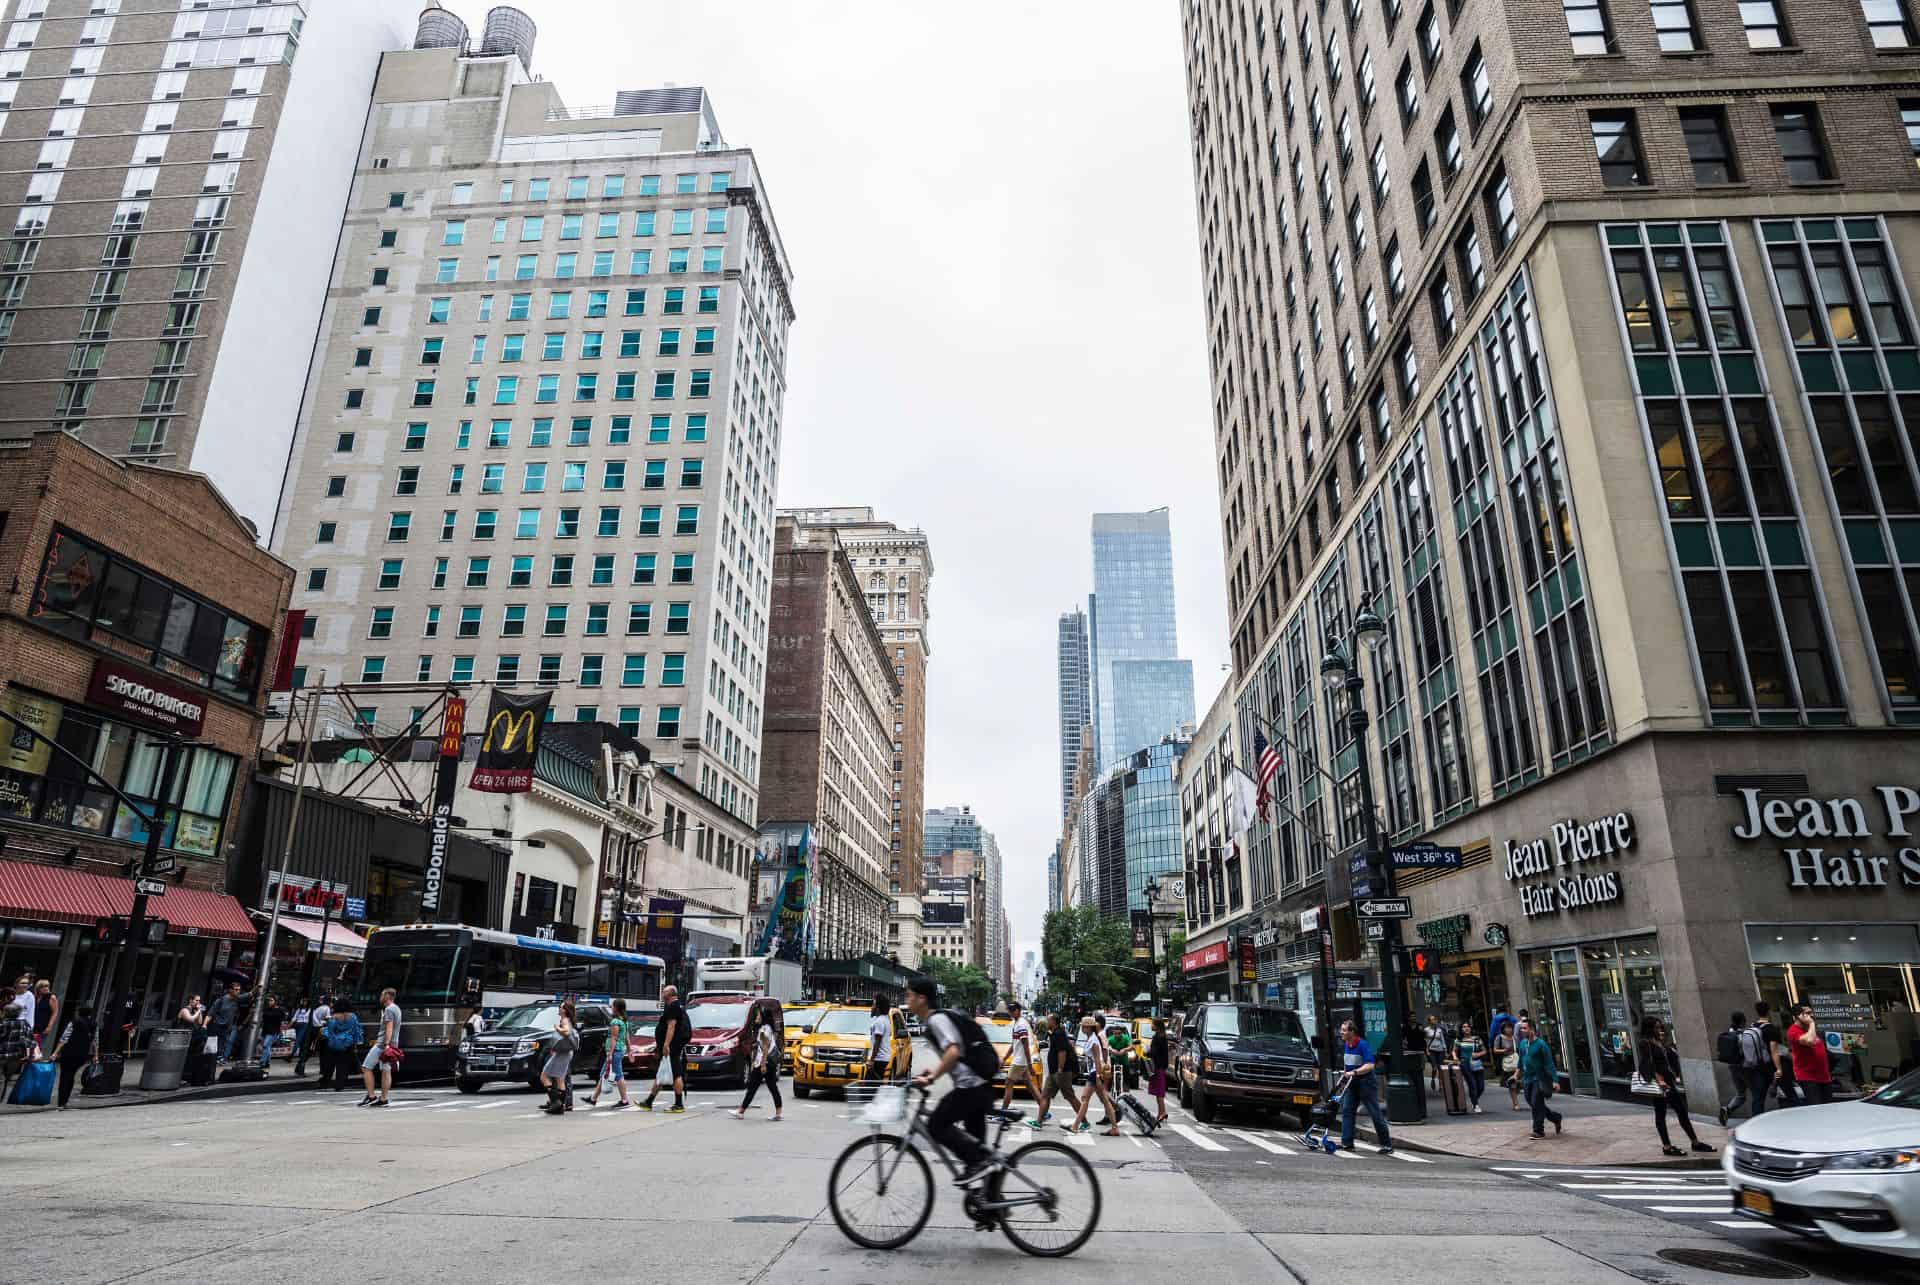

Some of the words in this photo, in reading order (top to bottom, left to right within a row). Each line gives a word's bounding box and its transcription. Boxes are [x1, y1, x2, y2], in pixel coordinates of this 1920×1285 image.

[155, 692, 201, 721] BURGER
[473, 775, 493, 787] OPEN
[494, 776, 506, 787] 24
[507, 775, 529, 788] HRS
[1734, 787, 1874, 840] Jean
[421, 804, 451, 909] McDonald's
[1392, 851, 1420, 863] West
[1422, 850, 1442, 863] 36th
[1444, 851, 1457, 863] St
[1503, 839, 1551, 881] Jean
[1551, 811, 1631, 867] Pierre
[1783, 847, 1890, 887] Hair
[1364, 904, 1379, 913] ONE
[1384, 904, 1400, 912] WAY
[1519, 882, 1555, 916] Hair
[1558, 871, 1618, 910] Salons
